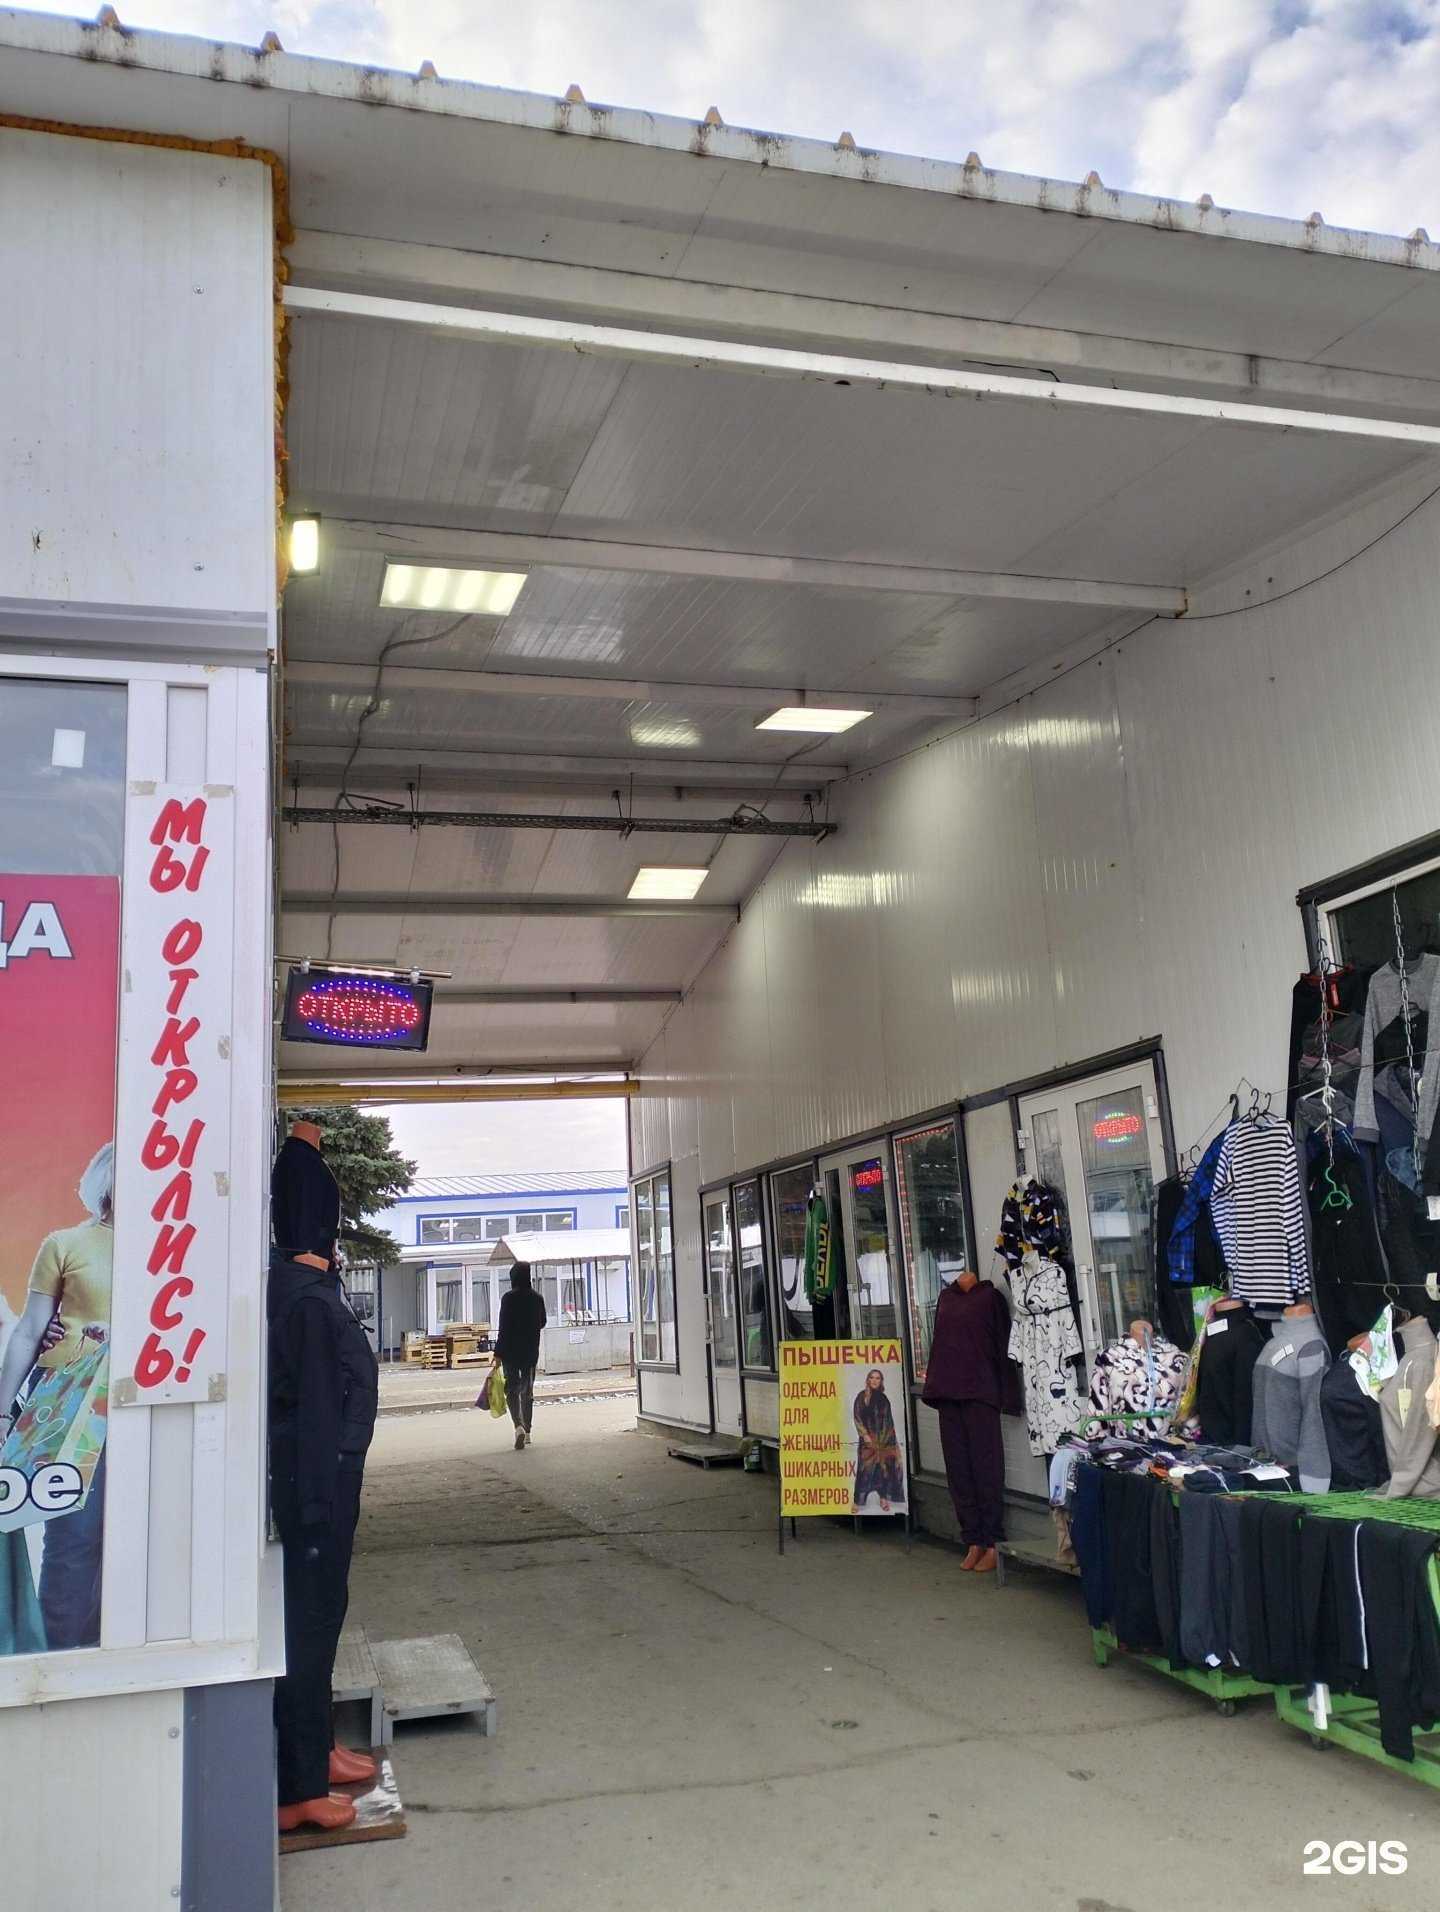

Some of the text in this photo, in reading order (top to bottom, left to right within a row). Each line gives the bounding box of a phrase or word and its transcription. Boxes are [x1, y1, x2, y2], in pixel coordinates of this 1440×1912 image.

[299, 993, 418, 1025] ОТКРЫТО
[134, 797, 210, 1388] МЫ ОТКРЫЛИСЬ!
[783, 1344, 900, 1366] ПЫШЕЧКА
[783, 1381, 837, 1399] ОДЕЖДА
[783, 1407, 810, 1426] ДЛЯ
[782, 1433, 841, 1453] ЖЕНЩИН
[783, 1459, 857, 1478] ШИКАРНЫХ
[784, 1488, 850, 1505] РАЗМЕРОВ
